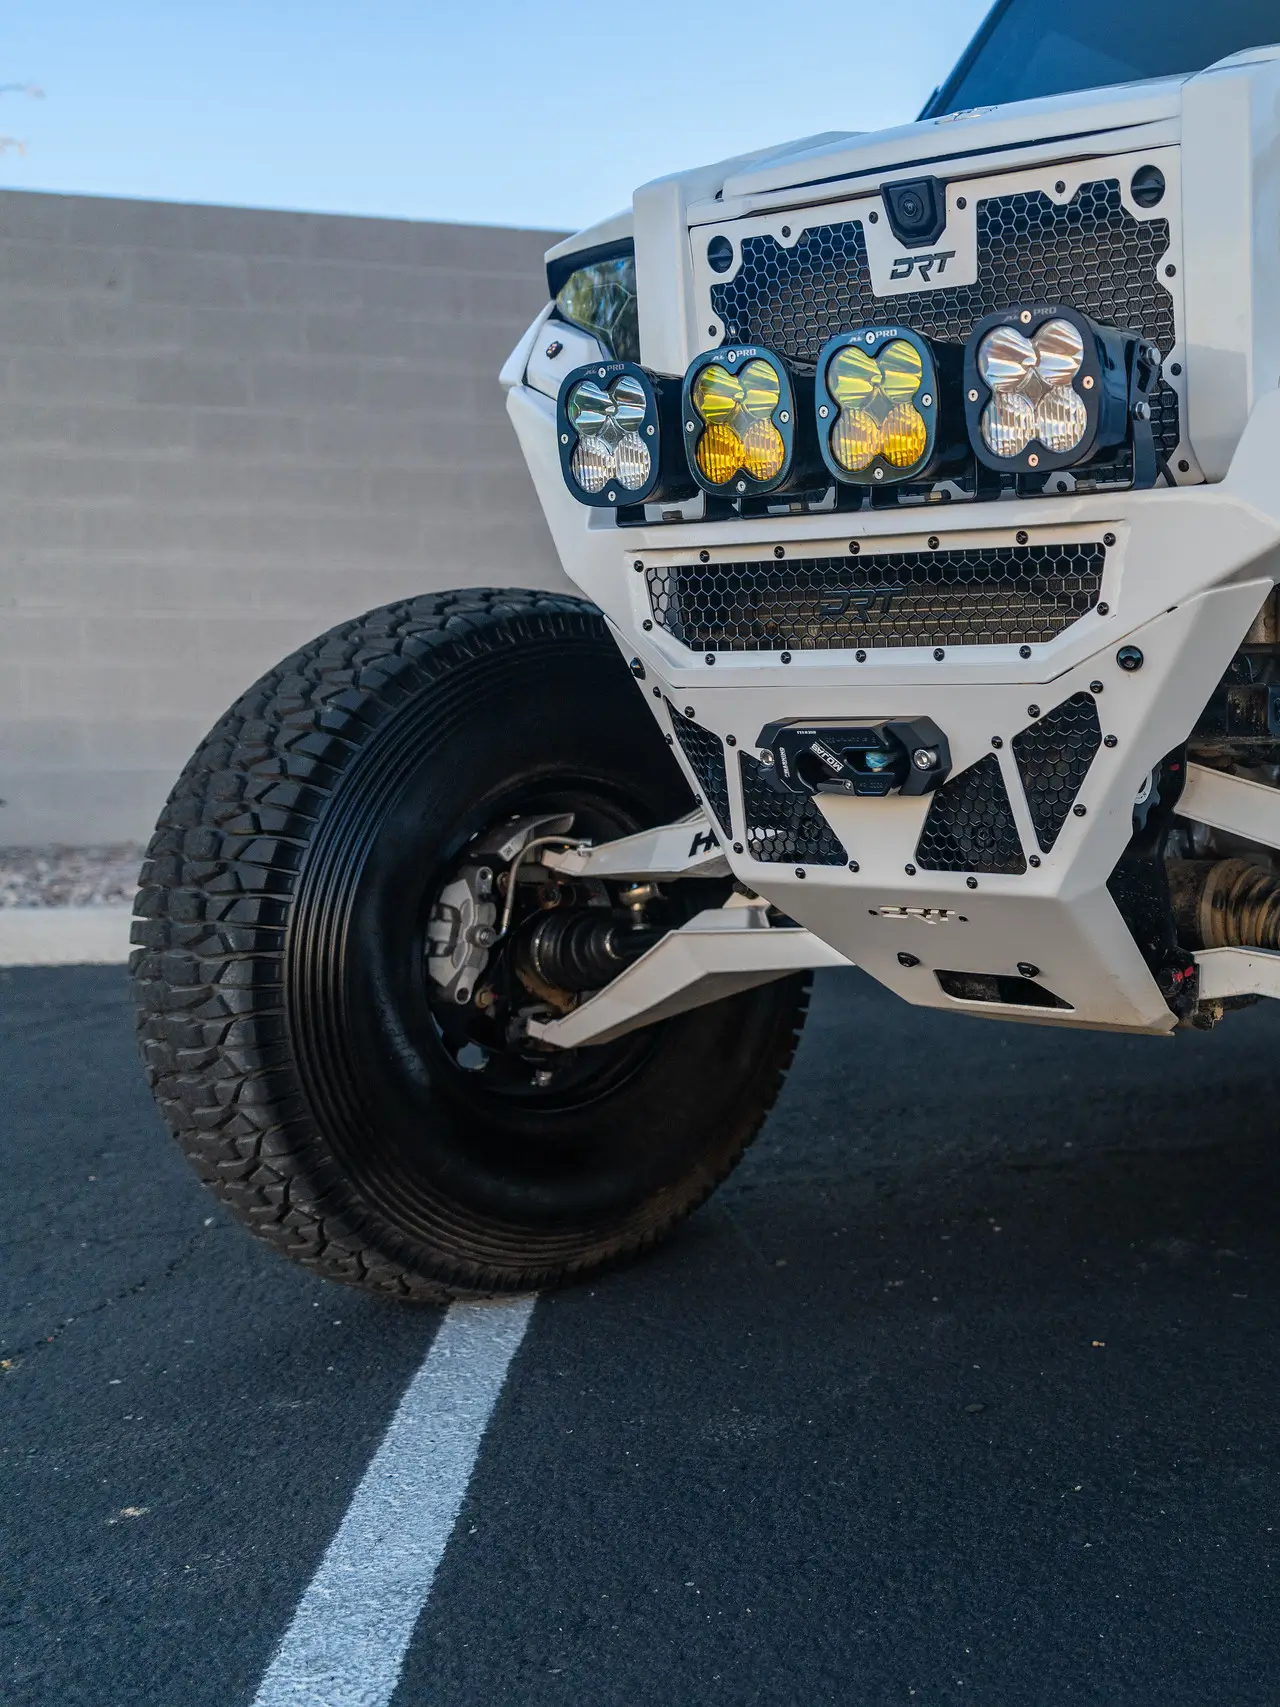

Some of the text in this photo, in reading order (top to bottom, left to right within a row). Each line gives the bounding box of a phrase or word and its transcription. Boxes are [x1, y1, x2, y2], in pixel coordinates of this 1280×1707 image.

[889, 250, 956, 282] DRT
[1033, 306, 1057, 316] PRO
[875, 329, 898, 338] PRO
[736, 348, 757, 358] PRO
[606, 363, 625, 371] PRO
[819, 587, 904, 622] DRT
